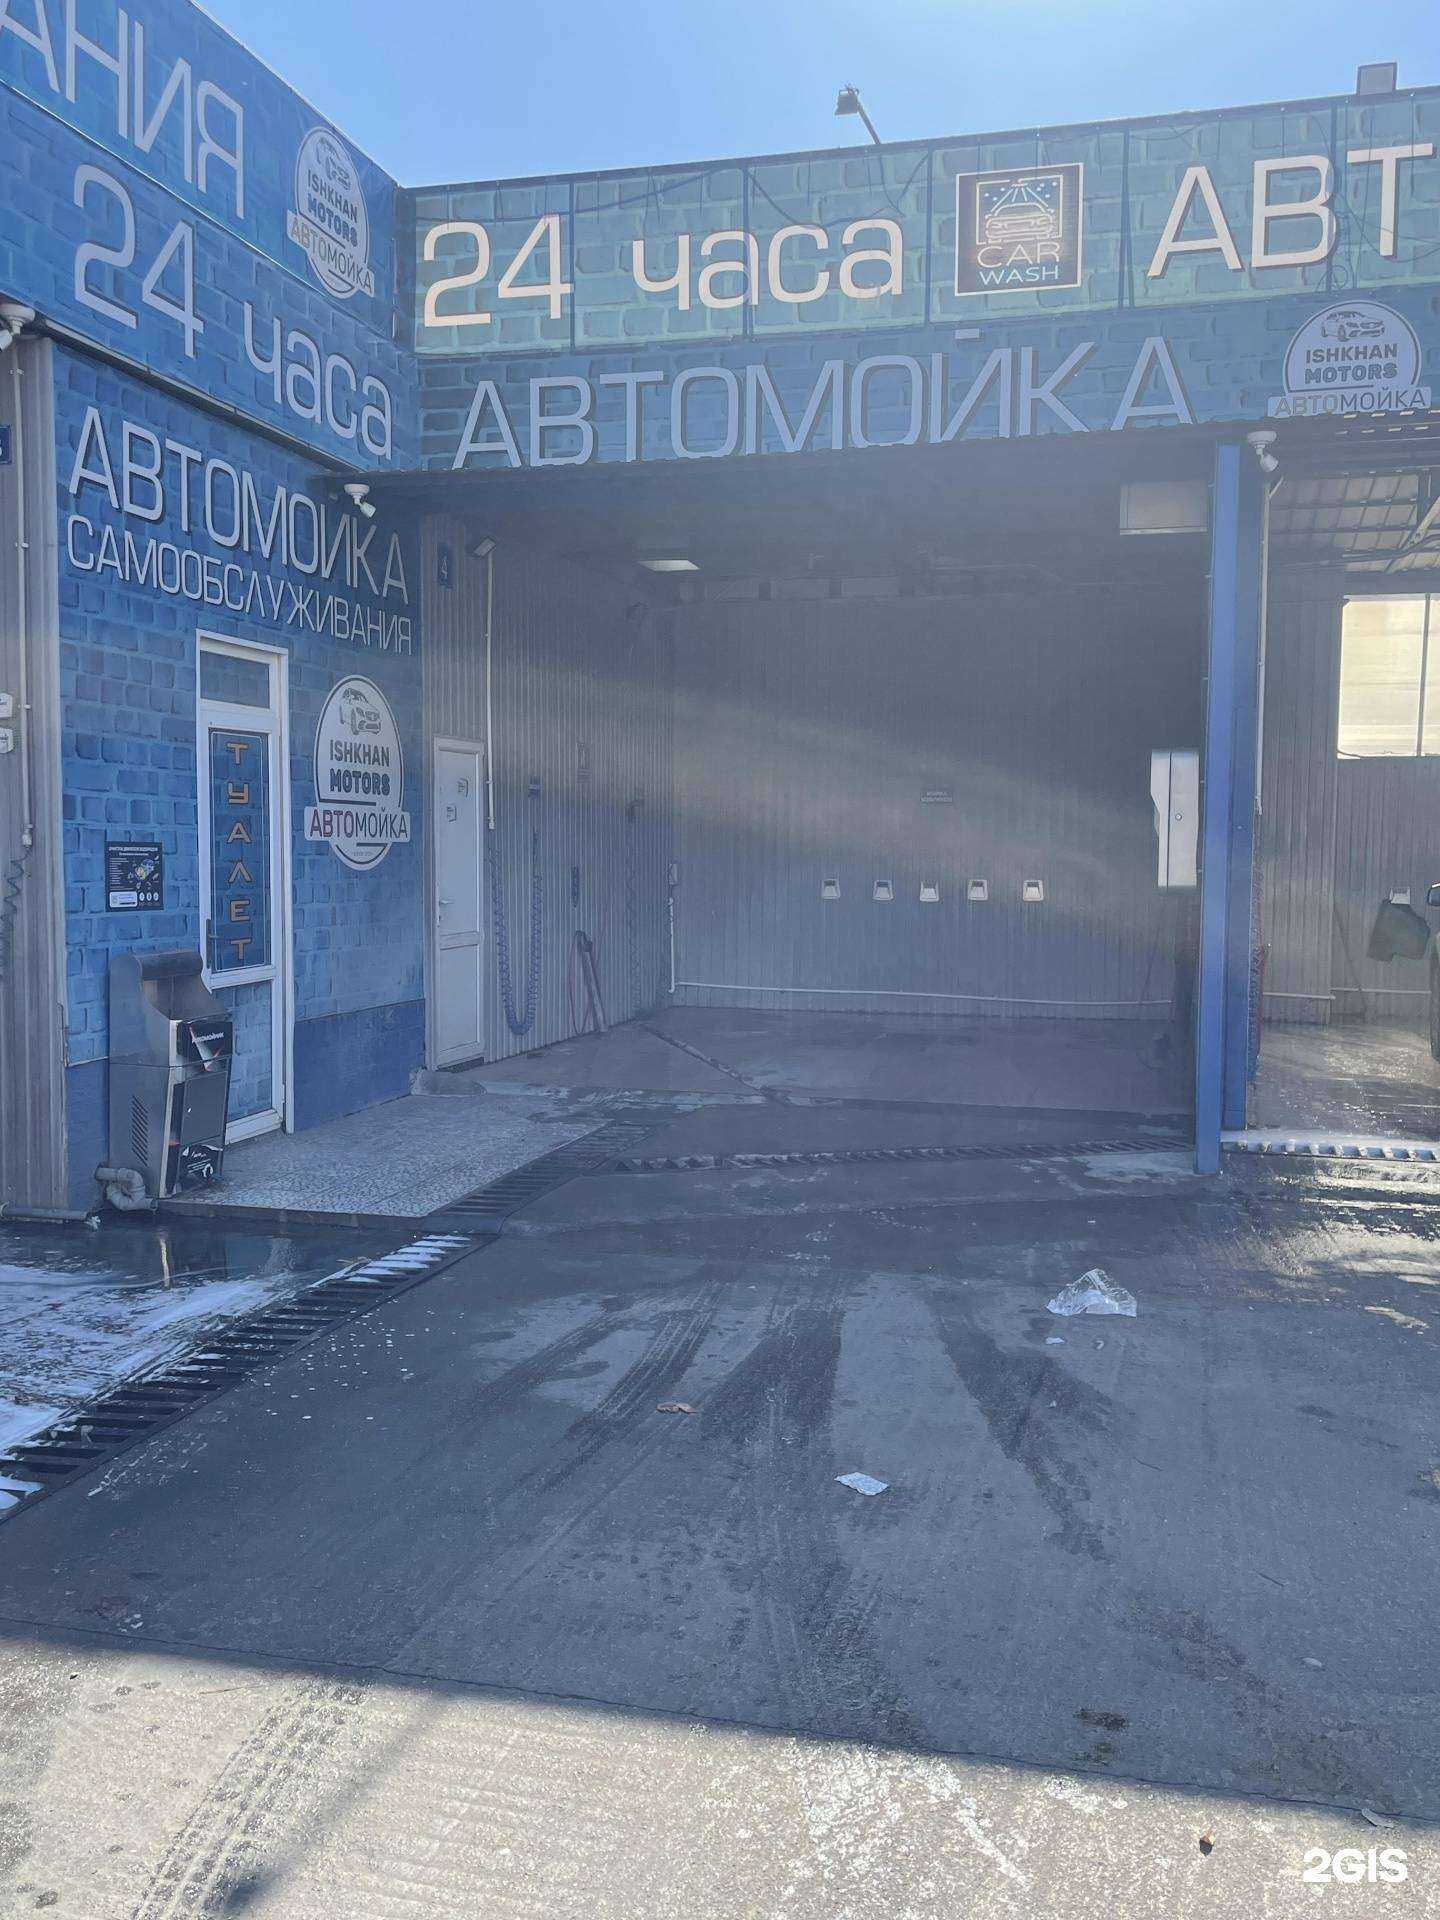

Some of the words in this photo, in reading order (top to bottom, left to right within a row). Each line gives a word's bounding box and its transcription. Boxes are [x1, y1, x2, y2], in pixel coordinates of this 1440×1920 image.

[307, 168, 358, 224] ISHKHAN
[1147, 143, 1434, 279] АВТ
[307, 192, 359, 248] MOTORS
[290, 215, 373, 294] АВТОМОЙКА
[423, 213, 574, 328] 24
[632, 217, 904, 311] часа
[977, 241, 1061, 268] CAR
[979, 265, 1059, 285] WASH
[74, 164, 204, 359] 24
[243, 302, 393, 460] часа
[1304, 362, 1398, 385] MOTORS
[1305, 343, 1398, 364] ISHKHAN
[1274, 386, 1426, 417] АВТОМОЙКА
[66, 514, 413, 656] САМООБСЛУЖИВАНИЯ
[329, 739, 390, 768] ISHKHAN
[329, 767, 391, 796] MOTORS
[309, 806, 409, 839] АВТОМОЙКА
[226, 742, 252, 961] ТУАЛЕТ
